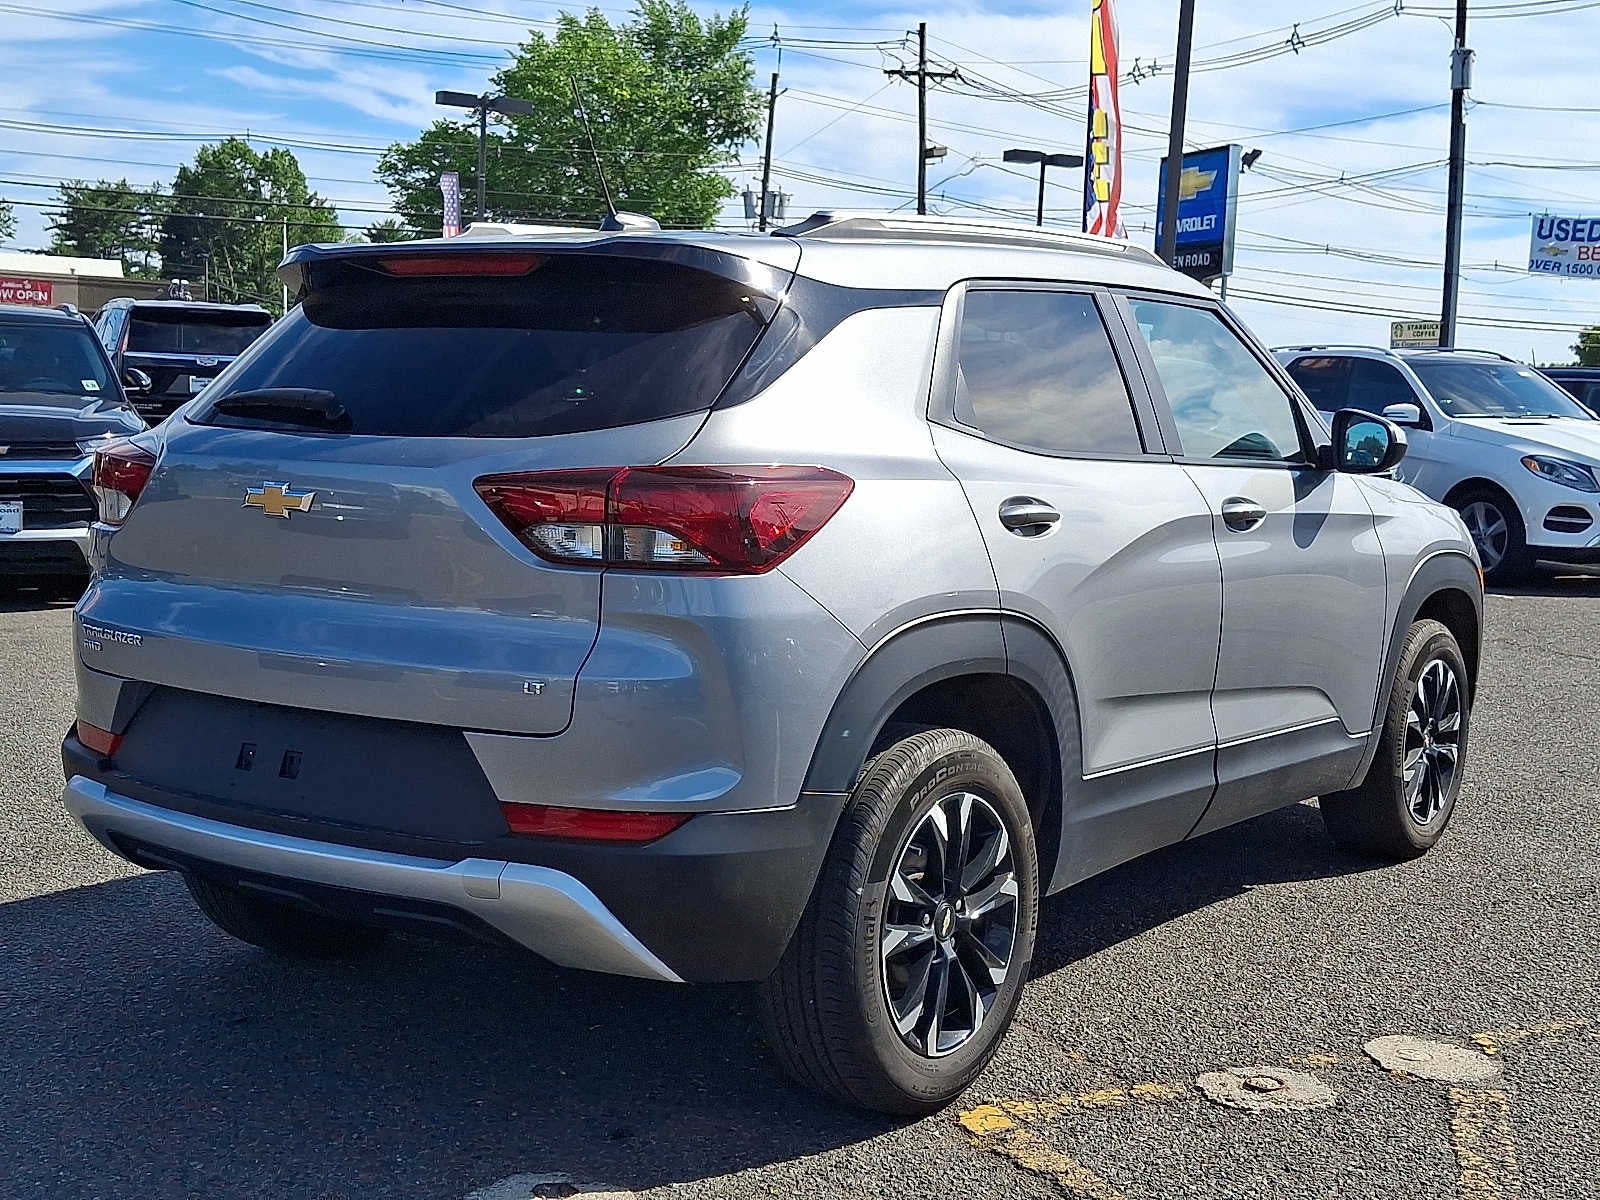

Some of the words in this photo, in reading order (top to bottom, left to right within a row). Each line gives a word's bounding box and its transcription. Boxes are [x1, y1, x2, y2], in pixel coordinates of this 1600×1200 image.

[1158, 215, 1217, 235] VROLET
[1537, 218, 1600, 242] USED
[1185, 253, 1210, 268] ROAD
[1567, 263, 1593, 274] 1500
[17, 290, 48, 301] OPEN
[82, 623, 142, 646] TRAILBLAZER
[523, 681, 545, 695] LT
